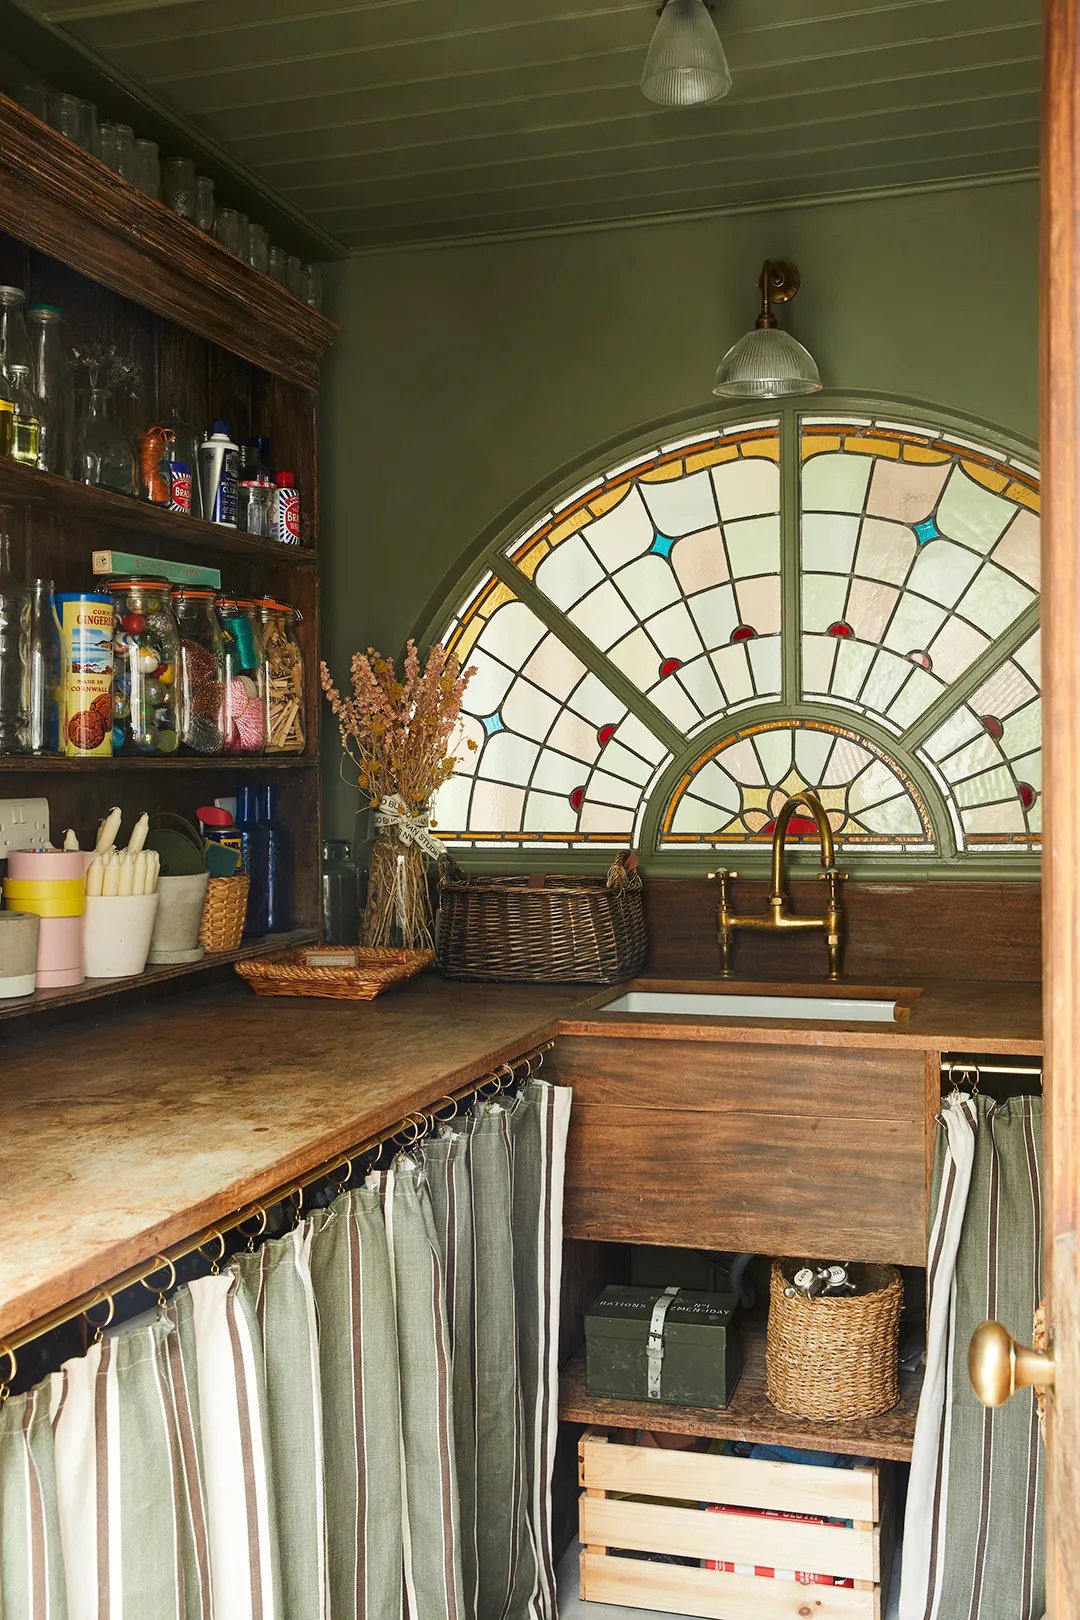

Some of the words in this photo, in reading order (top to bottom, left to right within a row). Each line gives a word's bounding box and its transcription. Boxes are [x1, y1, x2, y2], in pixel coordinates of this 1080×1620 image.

[135, 559, 173, 575] BICYCLE
[178, 566, 200, 577] PUMP
[599, 1300, 648, 1309] RATIONS
